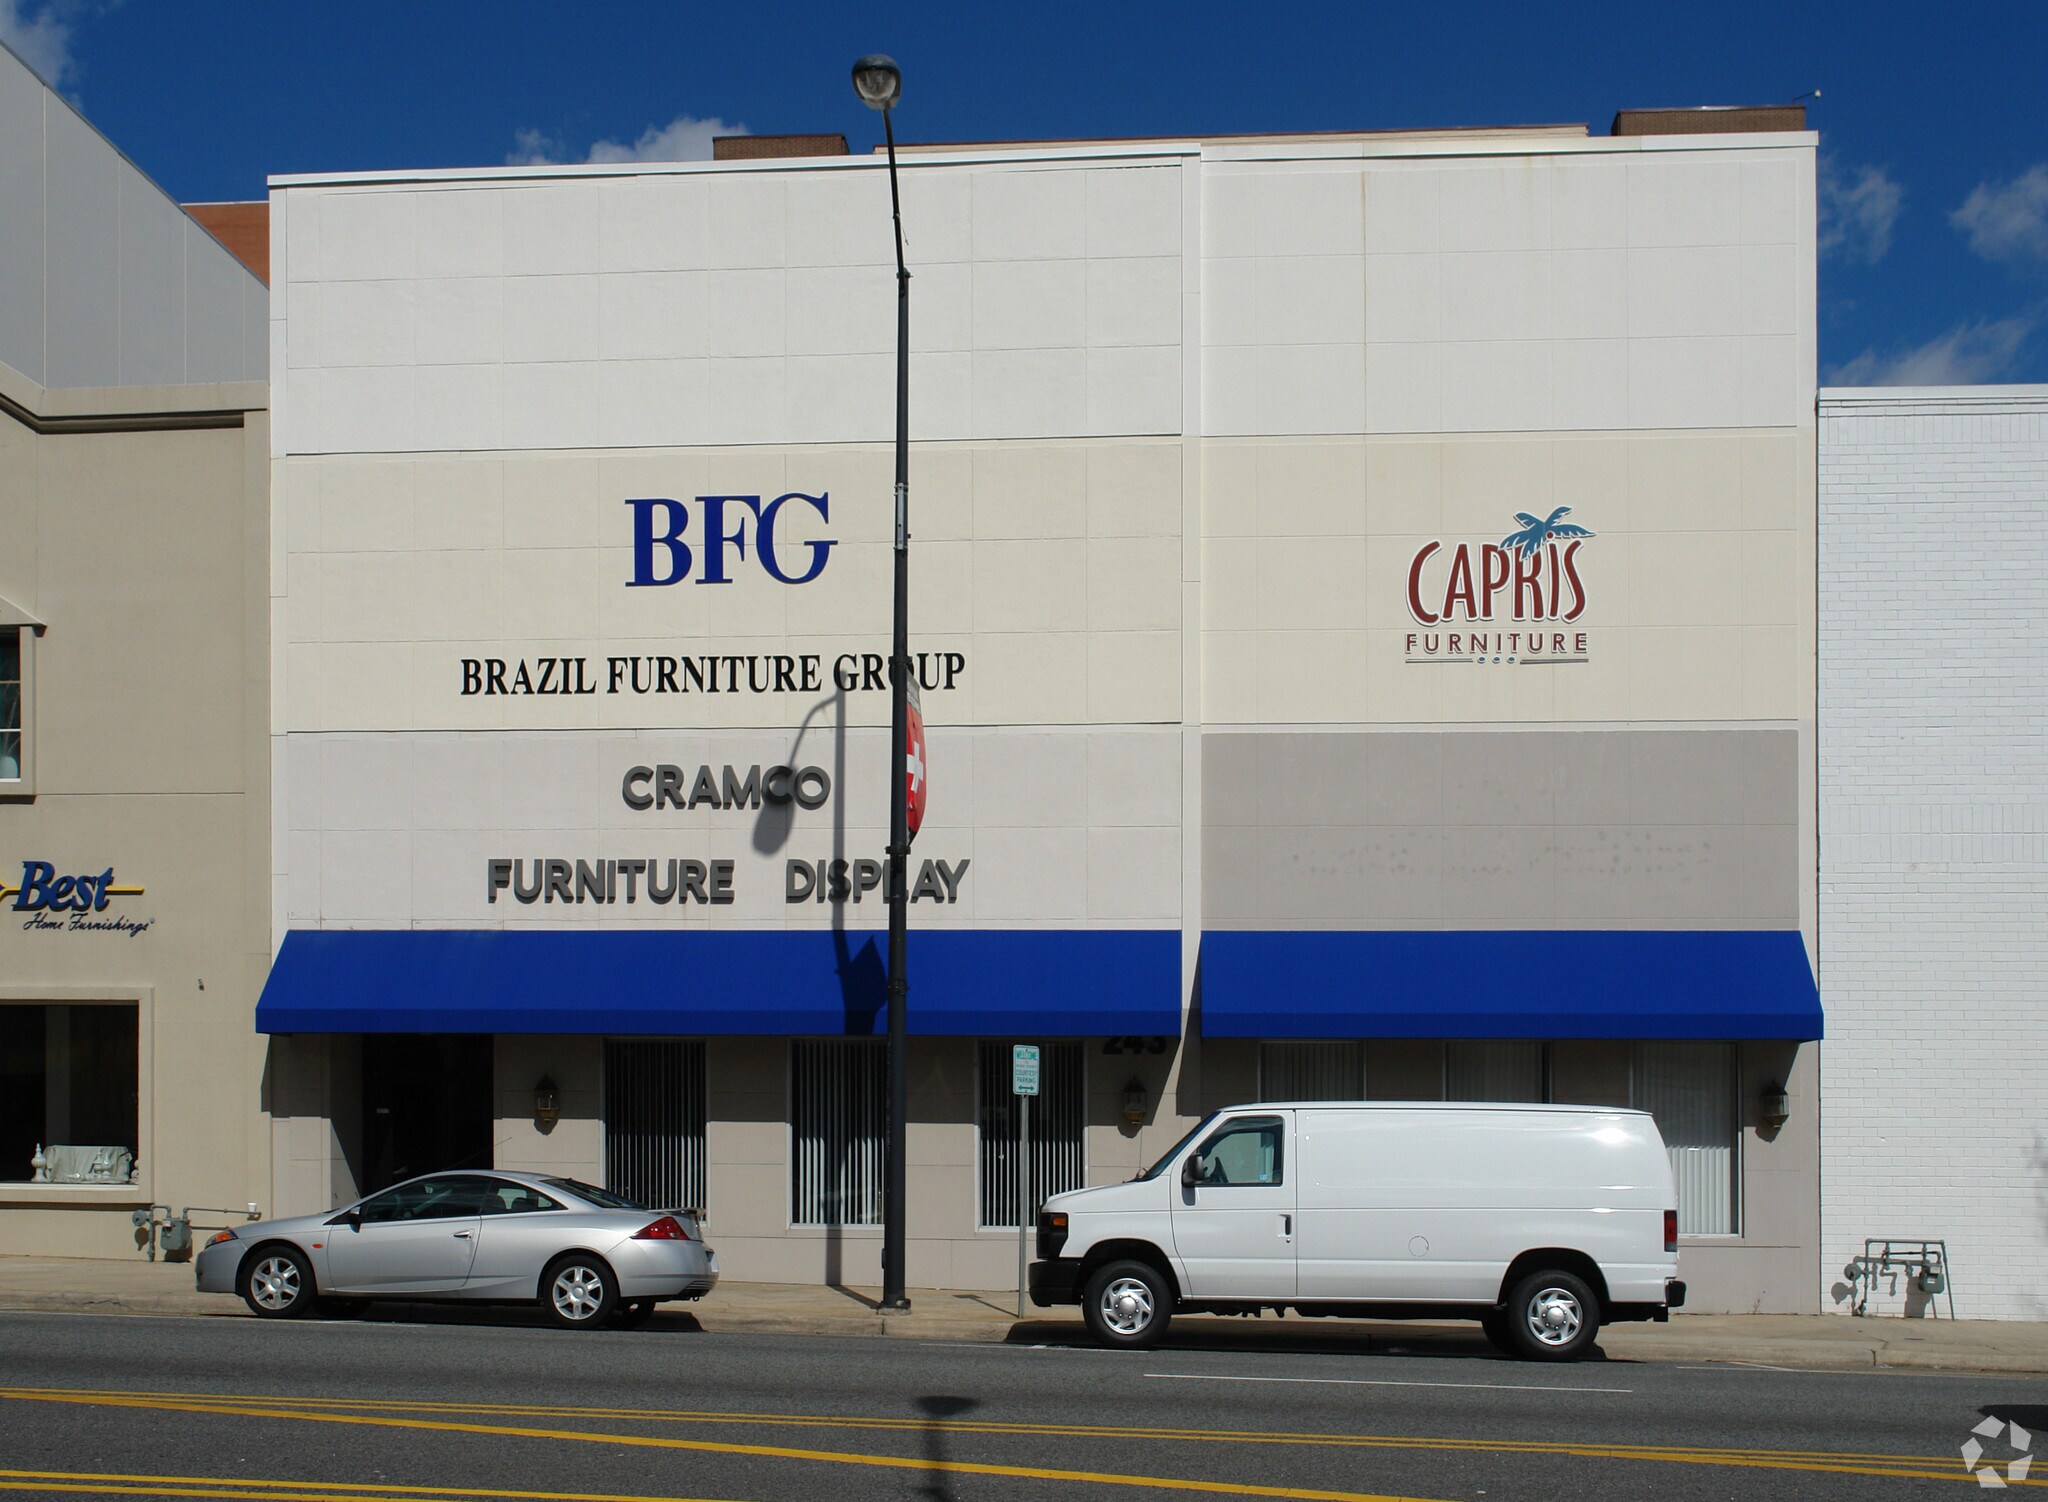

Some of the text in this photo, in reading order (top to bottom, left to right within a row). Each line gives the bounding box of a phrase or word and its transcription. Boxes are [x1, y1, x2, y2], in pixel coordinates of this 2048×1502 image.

[625, 492, 838, 587] BFG
[1405, 529, 1587, 627] CAPRIS
[1405, 632, 1588, 654] FURNITURE
[461, 658, 597, 695] BRAZIL
[607, 655, 822, 694] FURNITURE
[622, 765, 831, 810] CRAMCO
[12, 861, 115, 912] Best
[488, 859, 735, 905] FURNITURE
[23, 912, 149, 937] Home Furnishings
